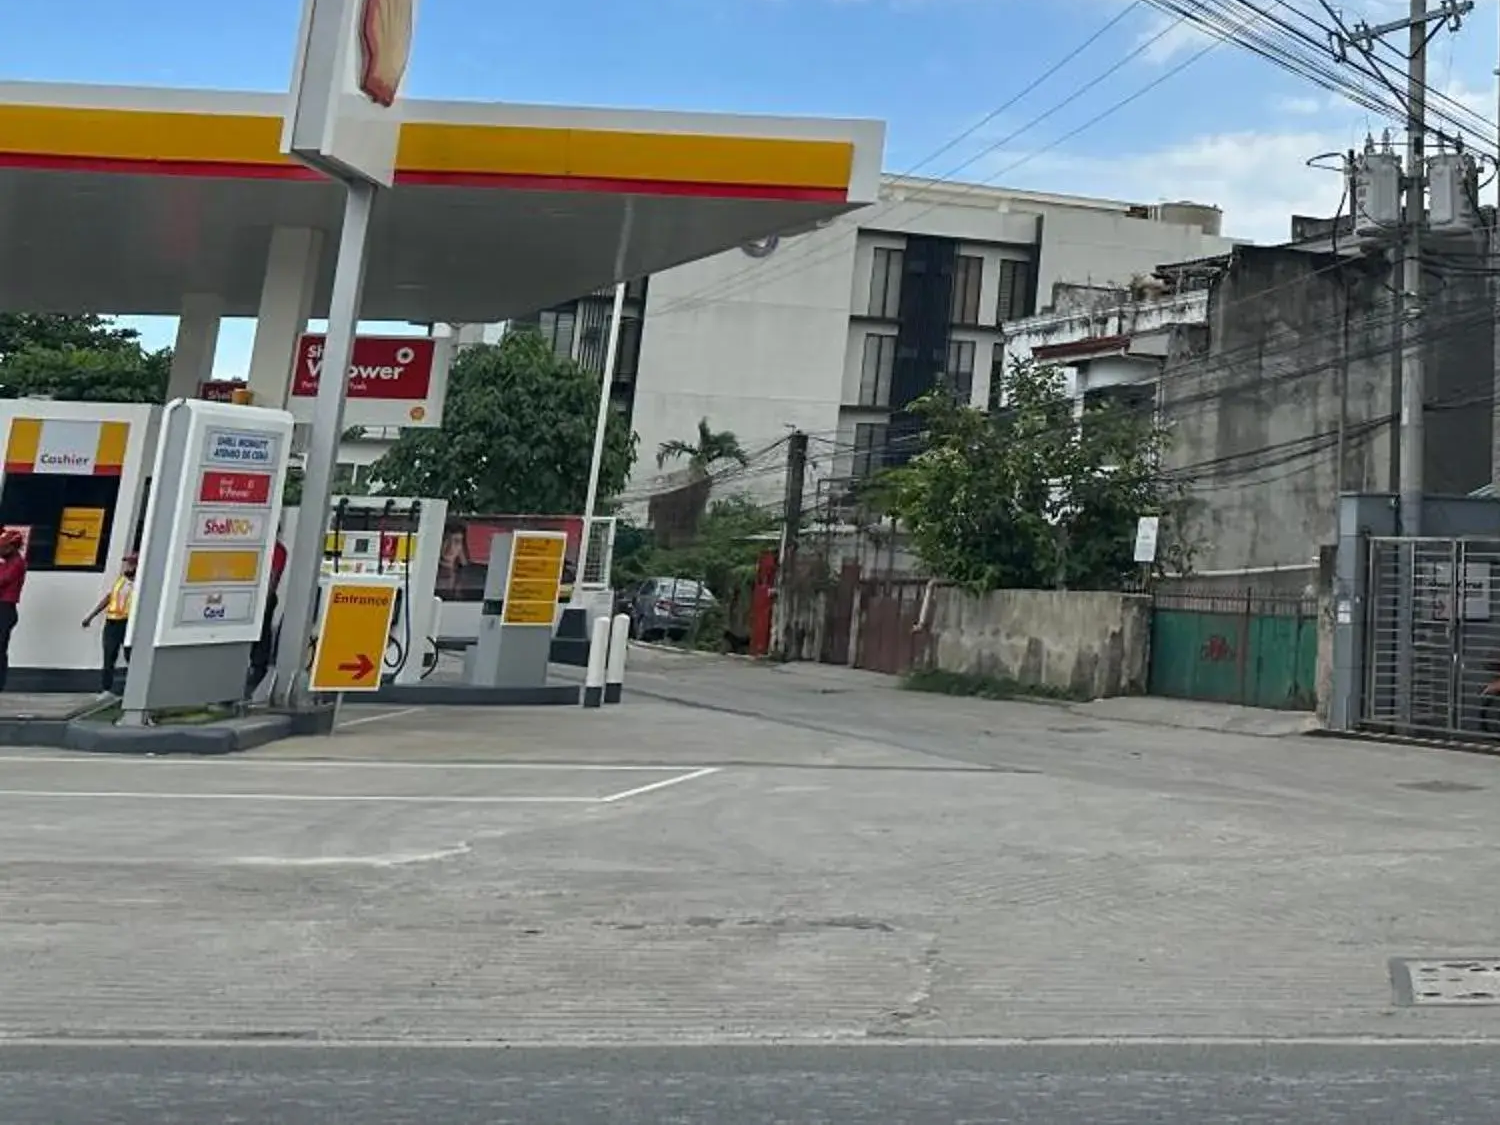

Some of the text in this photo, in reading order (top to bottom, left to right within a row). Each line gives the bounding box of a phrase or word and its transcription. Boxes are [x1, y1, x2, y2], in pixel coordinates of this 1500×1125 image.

[40, 453, 90, 465] Cashier
[333, 592, 389, 606] Entrance
[203, 606, 225, 619] Card
